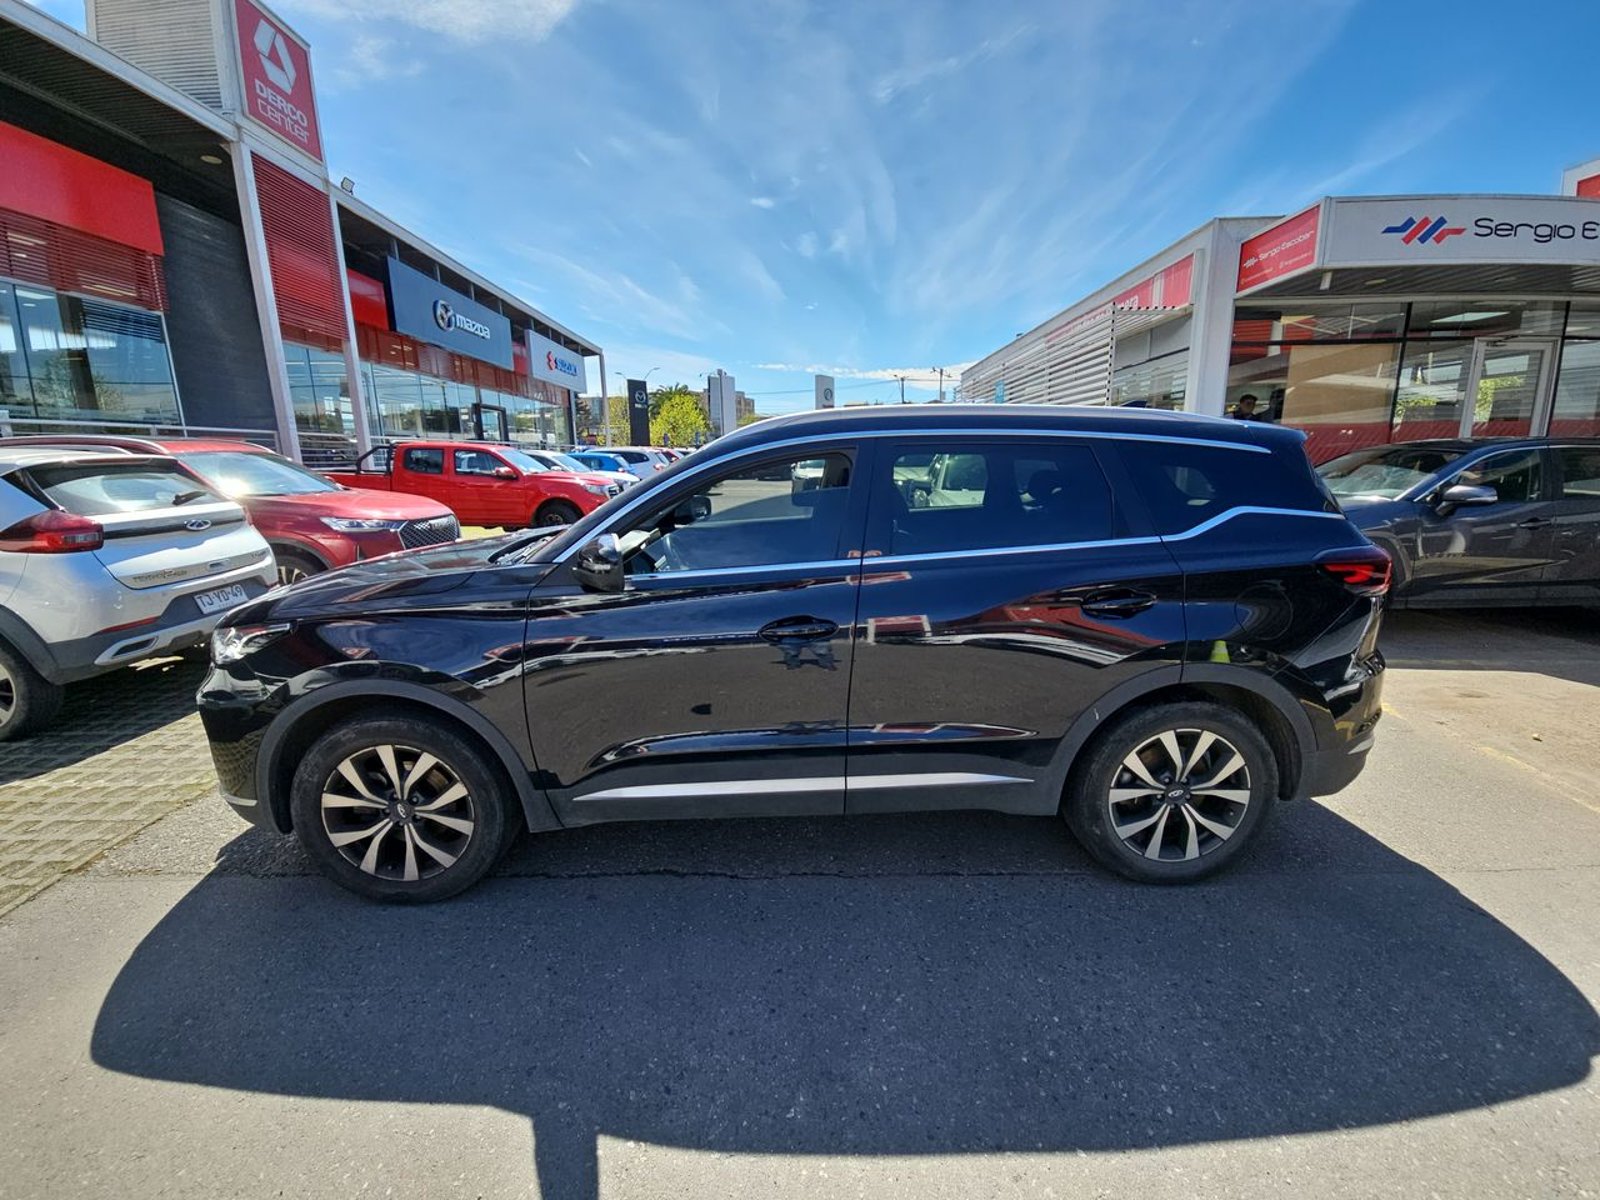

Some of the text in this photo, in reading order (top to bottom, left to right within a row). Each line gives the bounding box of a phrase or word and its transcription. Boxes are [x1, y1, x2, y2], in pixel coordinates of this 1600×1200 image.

[254, 79, 308, 127] DERCO
[1474, 217, 1576, 243] Sergio
[456, 313, 490, 339] mazda
